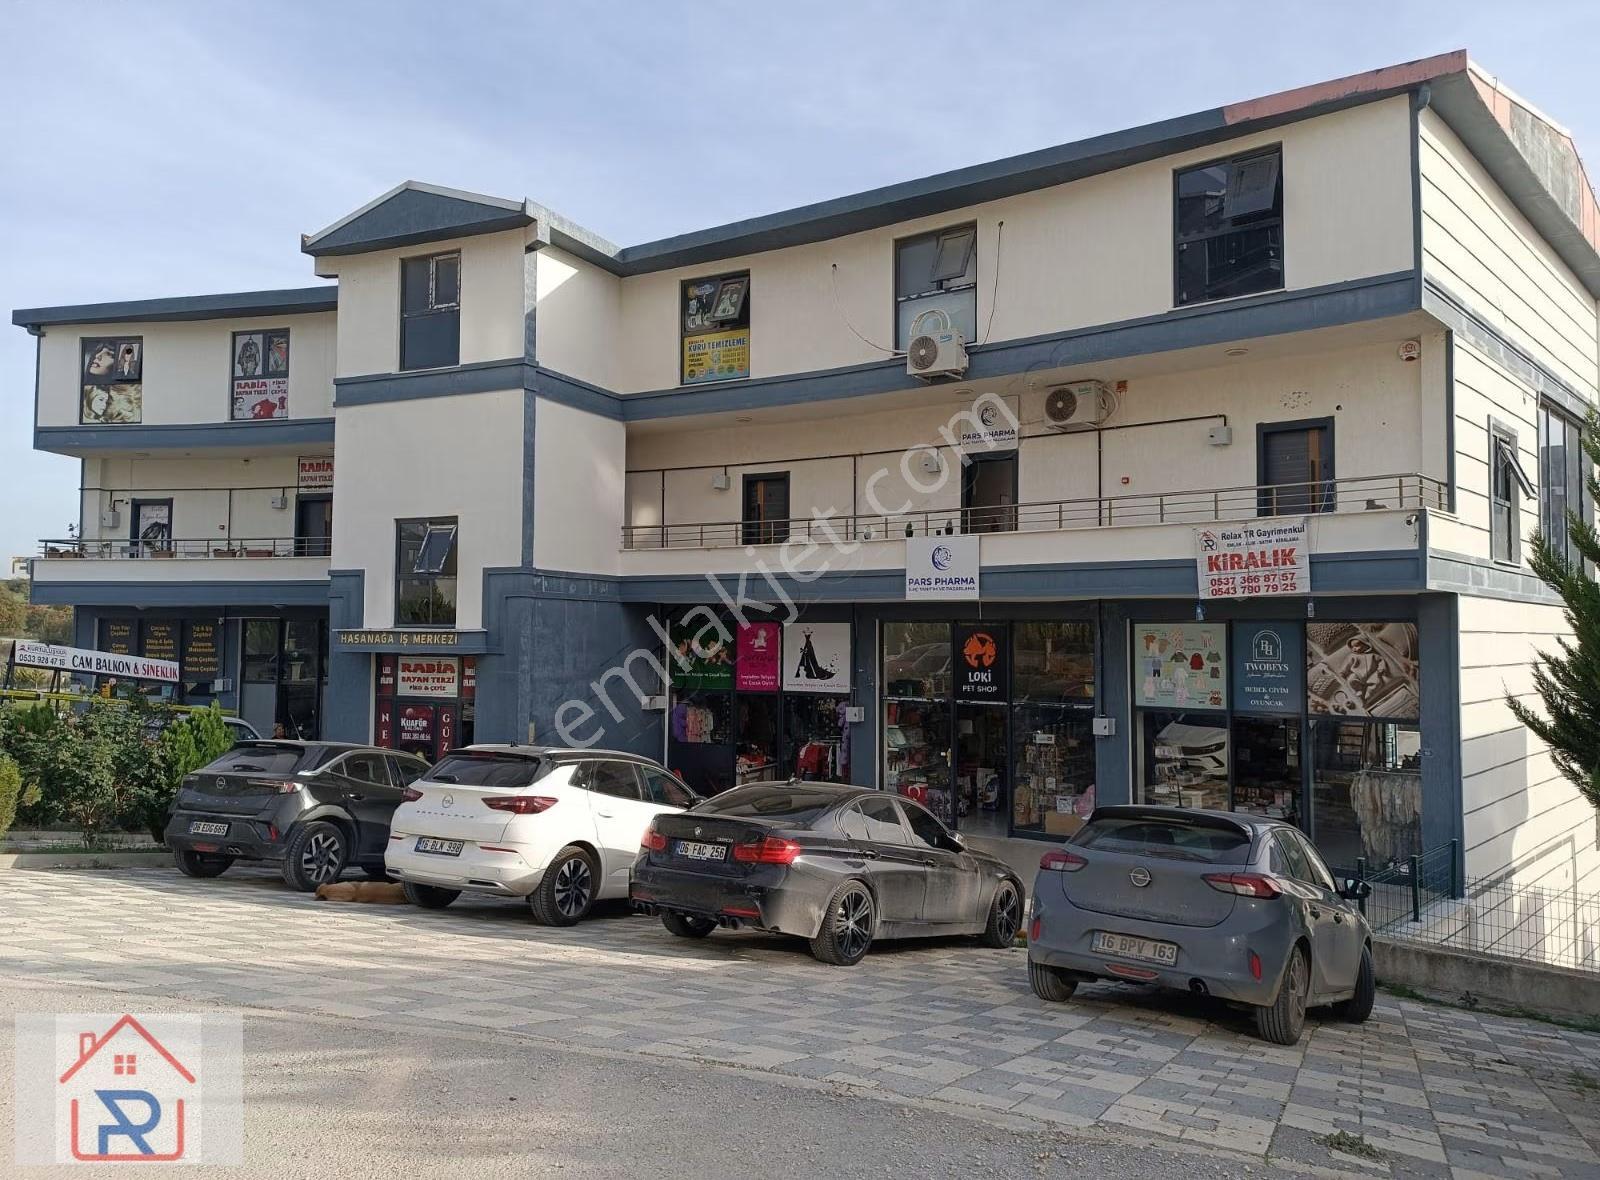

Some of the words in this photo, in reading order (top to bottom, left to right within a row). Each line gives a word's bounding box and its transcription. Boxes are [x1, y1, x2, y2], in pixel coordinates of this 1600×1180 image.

[688, 343, 706, 352] KURU
[962, 432, 982, 441] PARS
[983, 428, 1016, 438] PHARMA
[300, 460, 334, 473] RABİA
[1221, 531, 1242, 541] Relax
[1243, 530, 1254, 539] TR
[1256, 525, 1305, 538] Gayrimenkul
[1207, 547, 1297, 572] KİRALIK
[908, 578, 932, 586] PARS
[934, 576, 976, 585] PHARMA
[1210, 577, 1236, 587] 0537
[1263, 573, 1278, 583] 87
[1281, 572, 1296, 582] 57
[1211, 586, 1237, 596] 0543
[1241, 584, 1261, 594] 790
[1264, 583, 1279, 593] 79
[1282, 582, 1297, 592] 25
[340, 633, 394, 644] HASANAĞA
[400, 632, 409, 647] İŞ
[412, 633, 458, 645] MERKEZİ
[19, 653, 36, 663] 0533
[50, 657, 58, 665] 47
[71, 655, 92, 670] CAM
[95, 657, 131, 674] BALKON
[133, 663, 139, 674] &
[401, 659, 456, 674] RABİA
[1244, 662, 1289, 671] TWOBEYS
[401, 676, 429, 685] BAYAN
[430, 675, 455, 684] TERZİ
[968, 669, 992, 683] LOKİ
[962, 684, 975, 693] PET
[977, 685, 998, 693] SHOP
[679, 842, 690, 854] 06
[693, 843, 707, 856] FAC
[710, 846, 725, 858] 256
[1102, 935, 1114, 949] 16
[1119, 938, 1146, 954] BPV
[1152, 943, 1176, 960] 163
